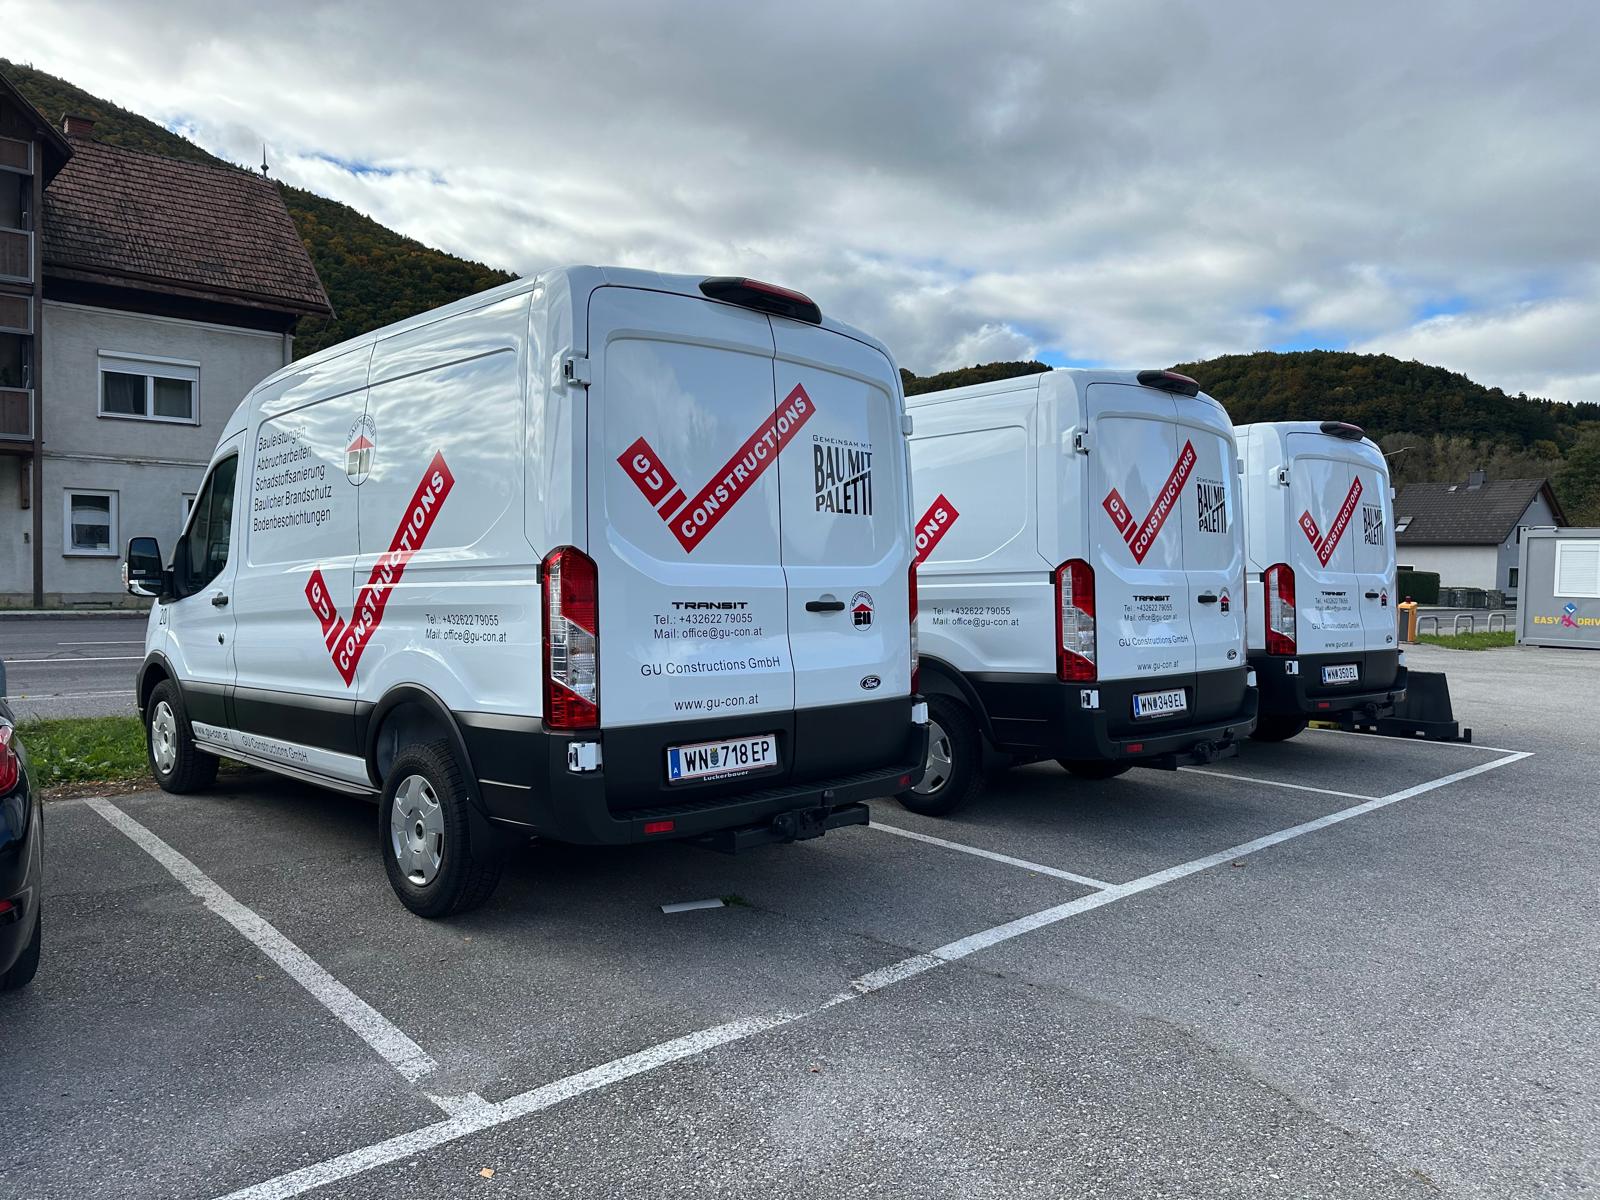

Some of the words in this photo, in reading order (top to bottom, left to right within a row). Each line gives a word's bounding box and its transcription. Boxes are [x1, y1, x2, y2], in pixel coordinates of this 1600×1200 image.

[258, 426, 306, 451] Bauleistungen
[812, 434, 859, 447] GEMEINSAM
[256, 445, 312, 471] Abbrucharbeiten
[681, 396, 807, 538] CONSTRUCTIONS
[255, 464, 325, 491] Schadstoffsanierung
[632, 453, 663, 491] GU
[254, 495, 285, 512] Baulicher
[285, 485, 332, 506] Brandschutz
[816, 470, 873, 516] PALETTI
[1135, 449, 1193, 554] CONSTRUCTIONS
[253, 508, 331, 532] Bodenbeschichtungen
[1110, 498, 1127, 523] GU
[1198, 500, 1227, 534] PALETTI
[1321, 483, 1360, 560] CONSTRUCTIONS
[1304, 518, 1315, 537] GU
[339, 471, 445, 670] CONSTRUCTIONS
[311, 582, 330, 620] GU
[671, 601, 749, 610] TRANSIT
[951, 606, 984, 616] +432622
[985, 606, 1011, 615] 79055
[653, 614, 676, 625] Tel.:
[679, 613, 722, 625] +432622
[725, 613, 753, 624] 79055
[952, 617, 1019, 628] office@gu-con.at
[1534, 616, 1560, 624] EASY
[425, 628, 442, 640] Mail:
[443, 629, 507, 644] office@gu-con.at
[653, 628, 679, 640] Mail:
[682, 627, 762, 640] office@gu-con.at
[1119, 638, 1131, 647] GU
[1132, 637, 1172, 646] Constructions
[640, 663, 662, 677] GU
[666, 658, 746, 675] Constructions
[748, 656, 781, 669] GmbH
[674, 693, 759, 711] www.gu-con.at
[684, 748, 709, 772] WN
[703, 770, 749, 781] Luckerbauer
